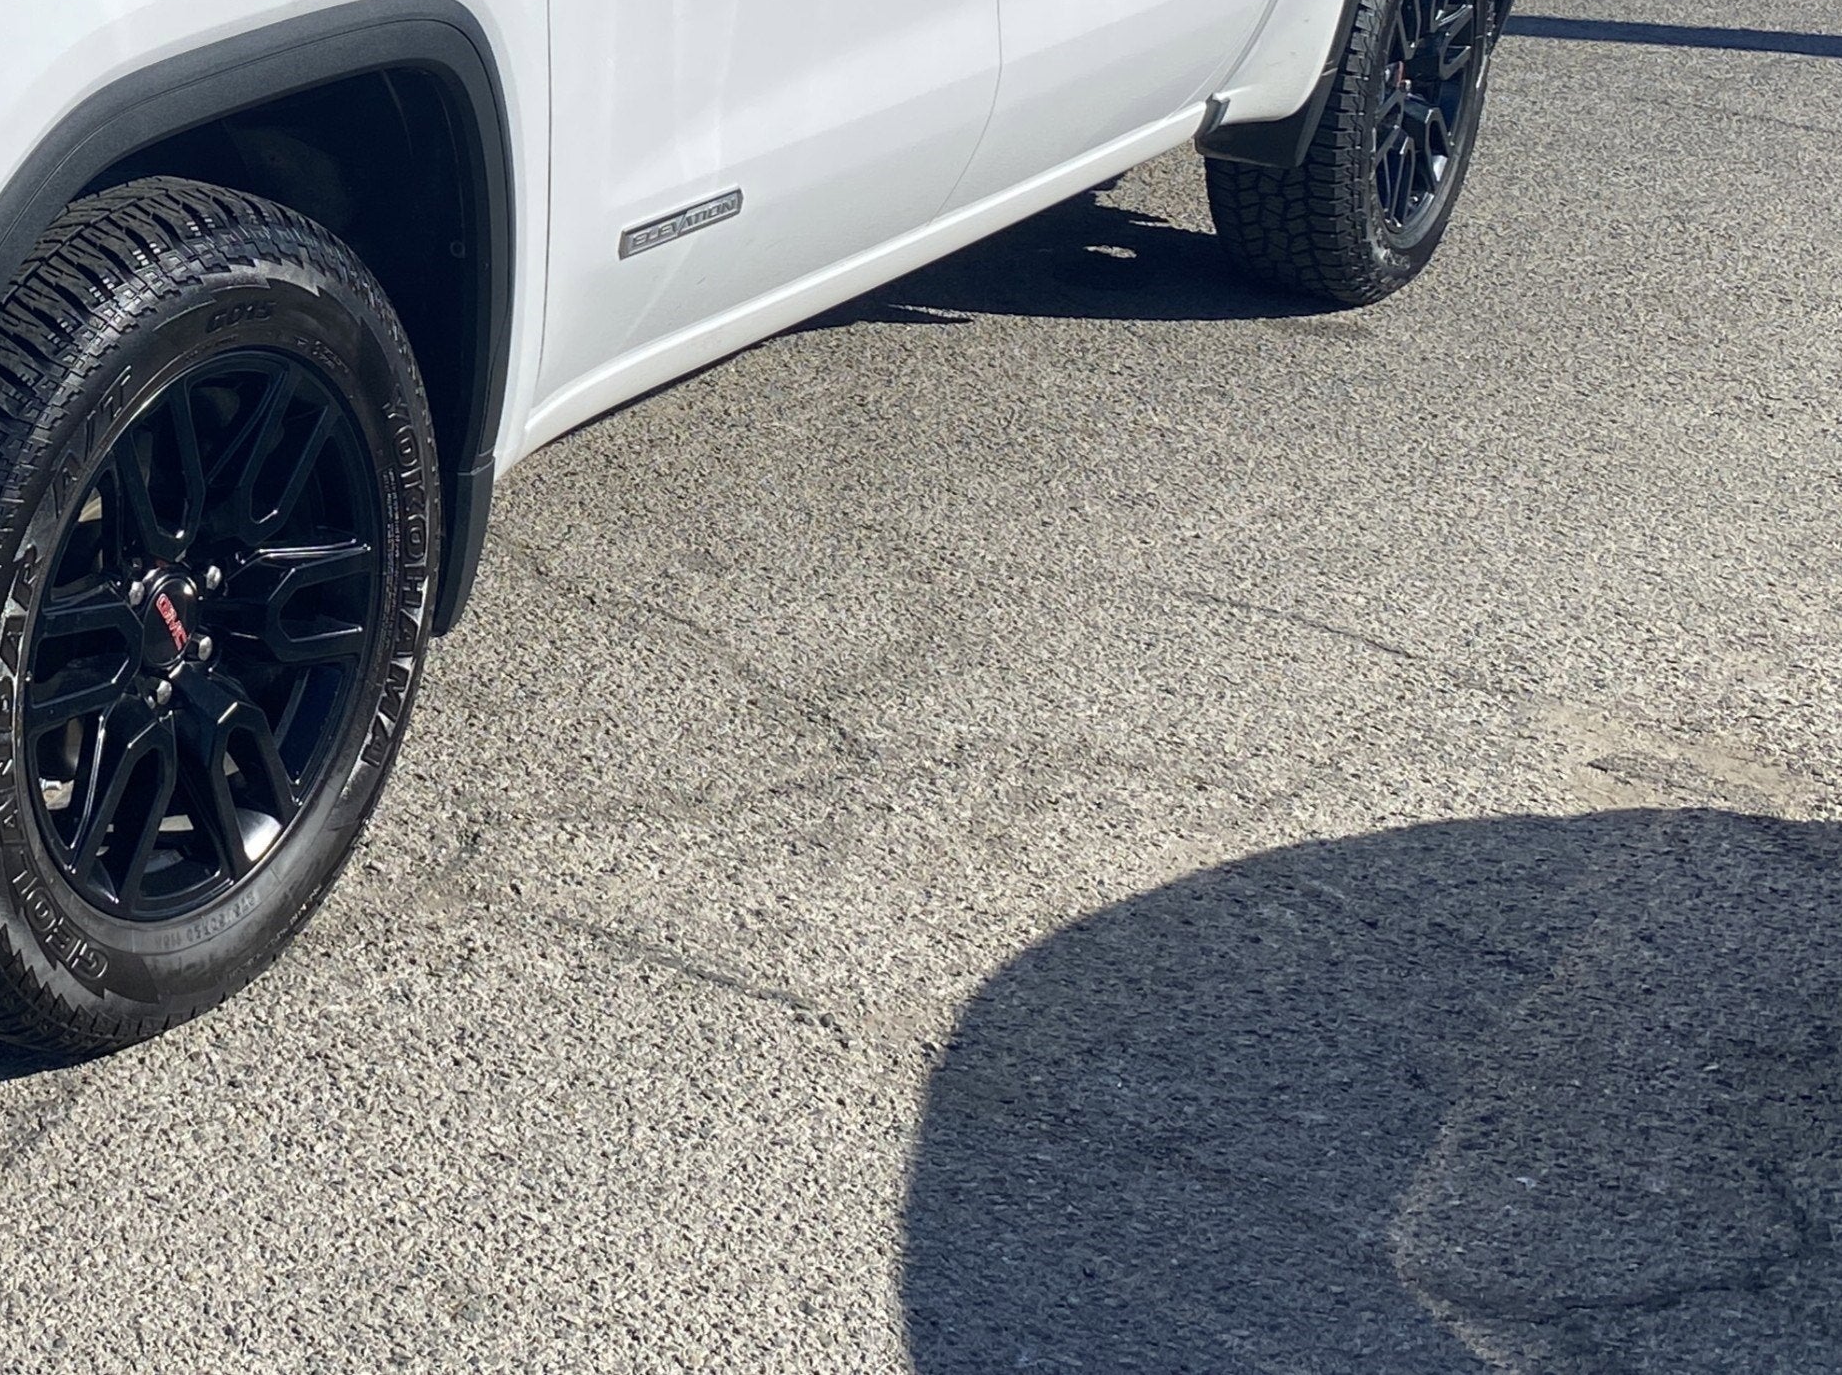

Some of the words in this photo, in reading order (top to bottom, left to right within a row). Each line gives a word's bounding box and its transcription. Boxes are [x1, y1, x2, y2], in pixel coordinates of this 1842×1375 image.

[631, 196, 738, 248] ELEVATION
[360, 382, 428, 767] YOKOHAMA
[156, 592, 188, 651] GMC
